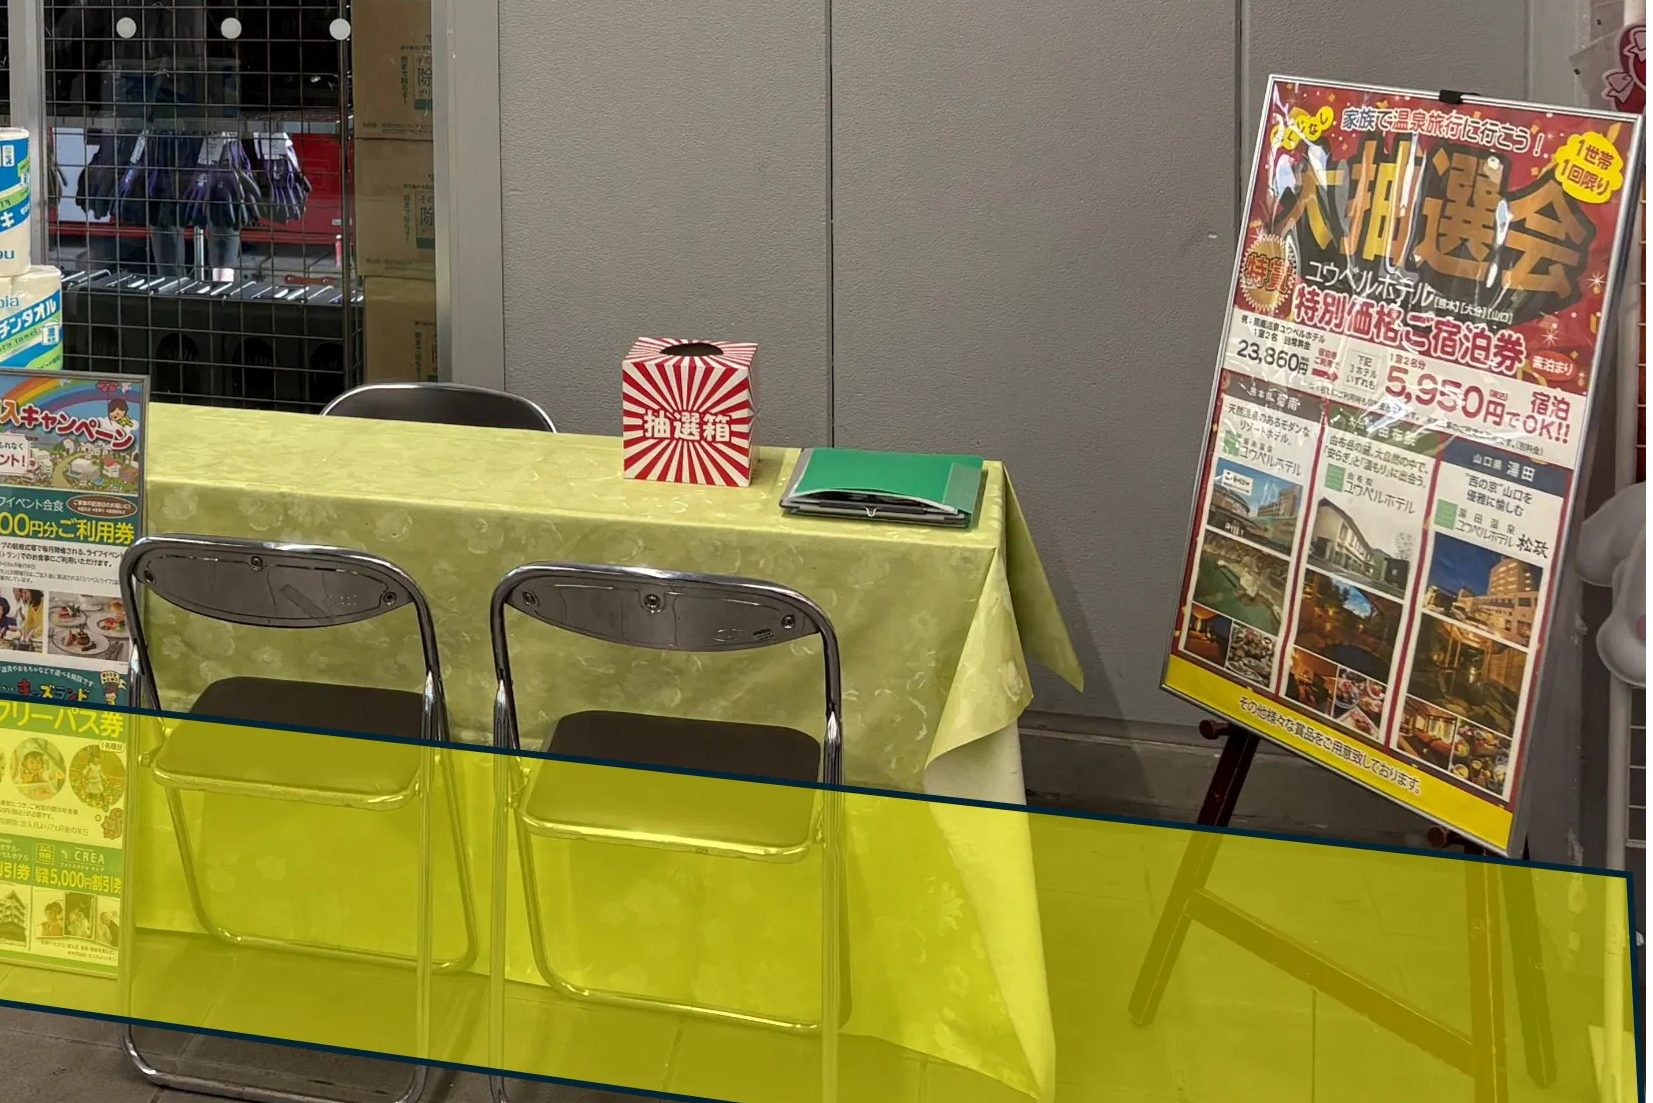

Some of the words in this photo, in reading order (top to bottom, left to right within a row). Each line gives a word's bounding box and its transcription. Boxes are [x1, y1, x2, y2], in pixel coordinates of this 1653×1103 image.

[1578, 140, 1614, 170] 1世帯
[1561, 159, 1610, 196] 1回限り
[1276, 141, 1585, 298] 大抽選会
[1306, 260, 1435, 308] ユウベルホテル
[1295, 285, 1526, 375] 特別価格ご宿泊券
[1237, 339, 1309, 376] 23,860円
[1531, 392, 1571, 421] 宿泊
[643, 410, 732, 443] 抽選箱
[1240, 447, 1302, 477] ユウベルホテル
[1344, 482, 1416, 514] ユウベルホテル
[1456, 520, 1514, 548] ユウベルホテル
[74, 851, 105, 864] CREA
